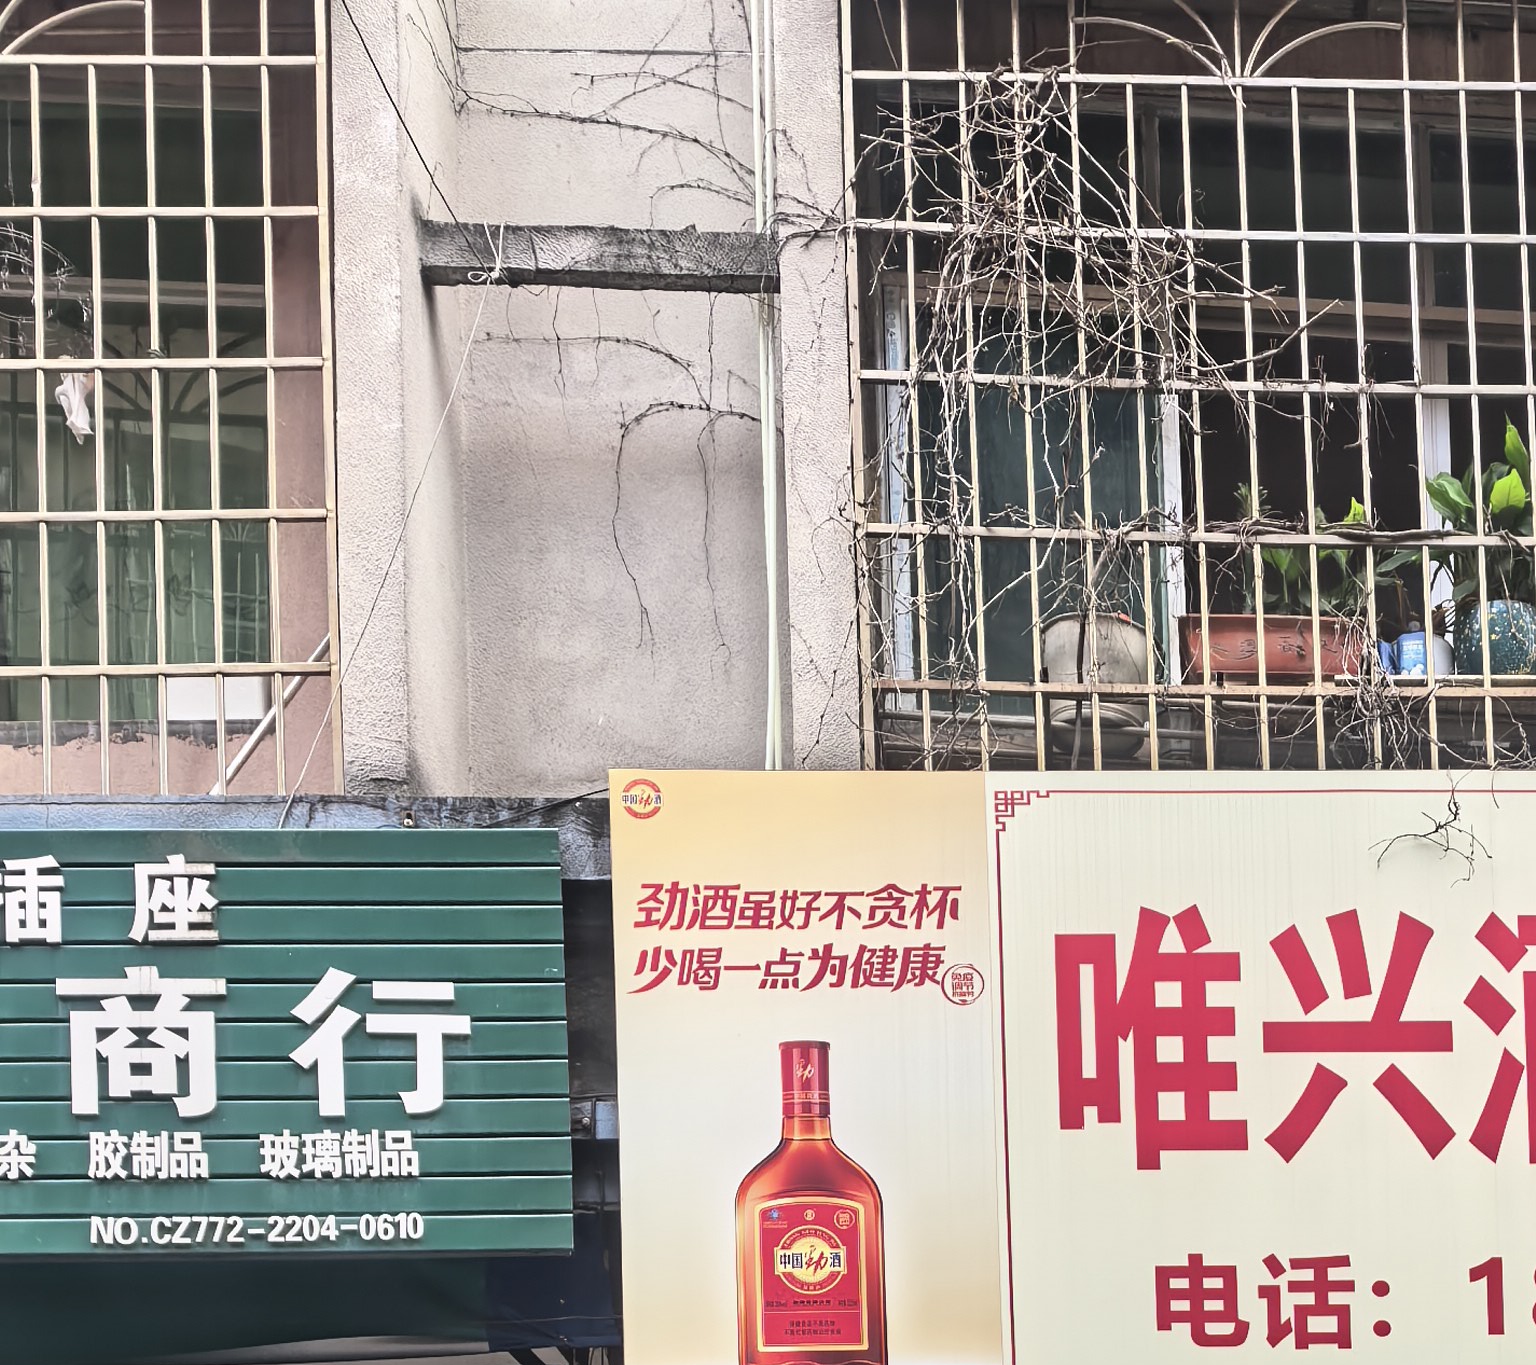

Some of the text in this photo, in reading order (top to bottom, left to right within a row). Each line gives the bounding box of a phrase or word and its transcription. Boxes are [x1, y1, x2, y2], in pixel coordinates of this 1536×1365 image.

[634, 881, 962, 932] 劲酒虽好不贪杯
[627, 943, 946, 994] 少喝一点为健康
[54, 965, 472, 1118] 商行
[87, 1130, 209, 1180] 胶制品
[259, 1128, 420, 1179] 玻璃制品
[89, 1211, 425, 1246] NO.CZ772-2204-0610
